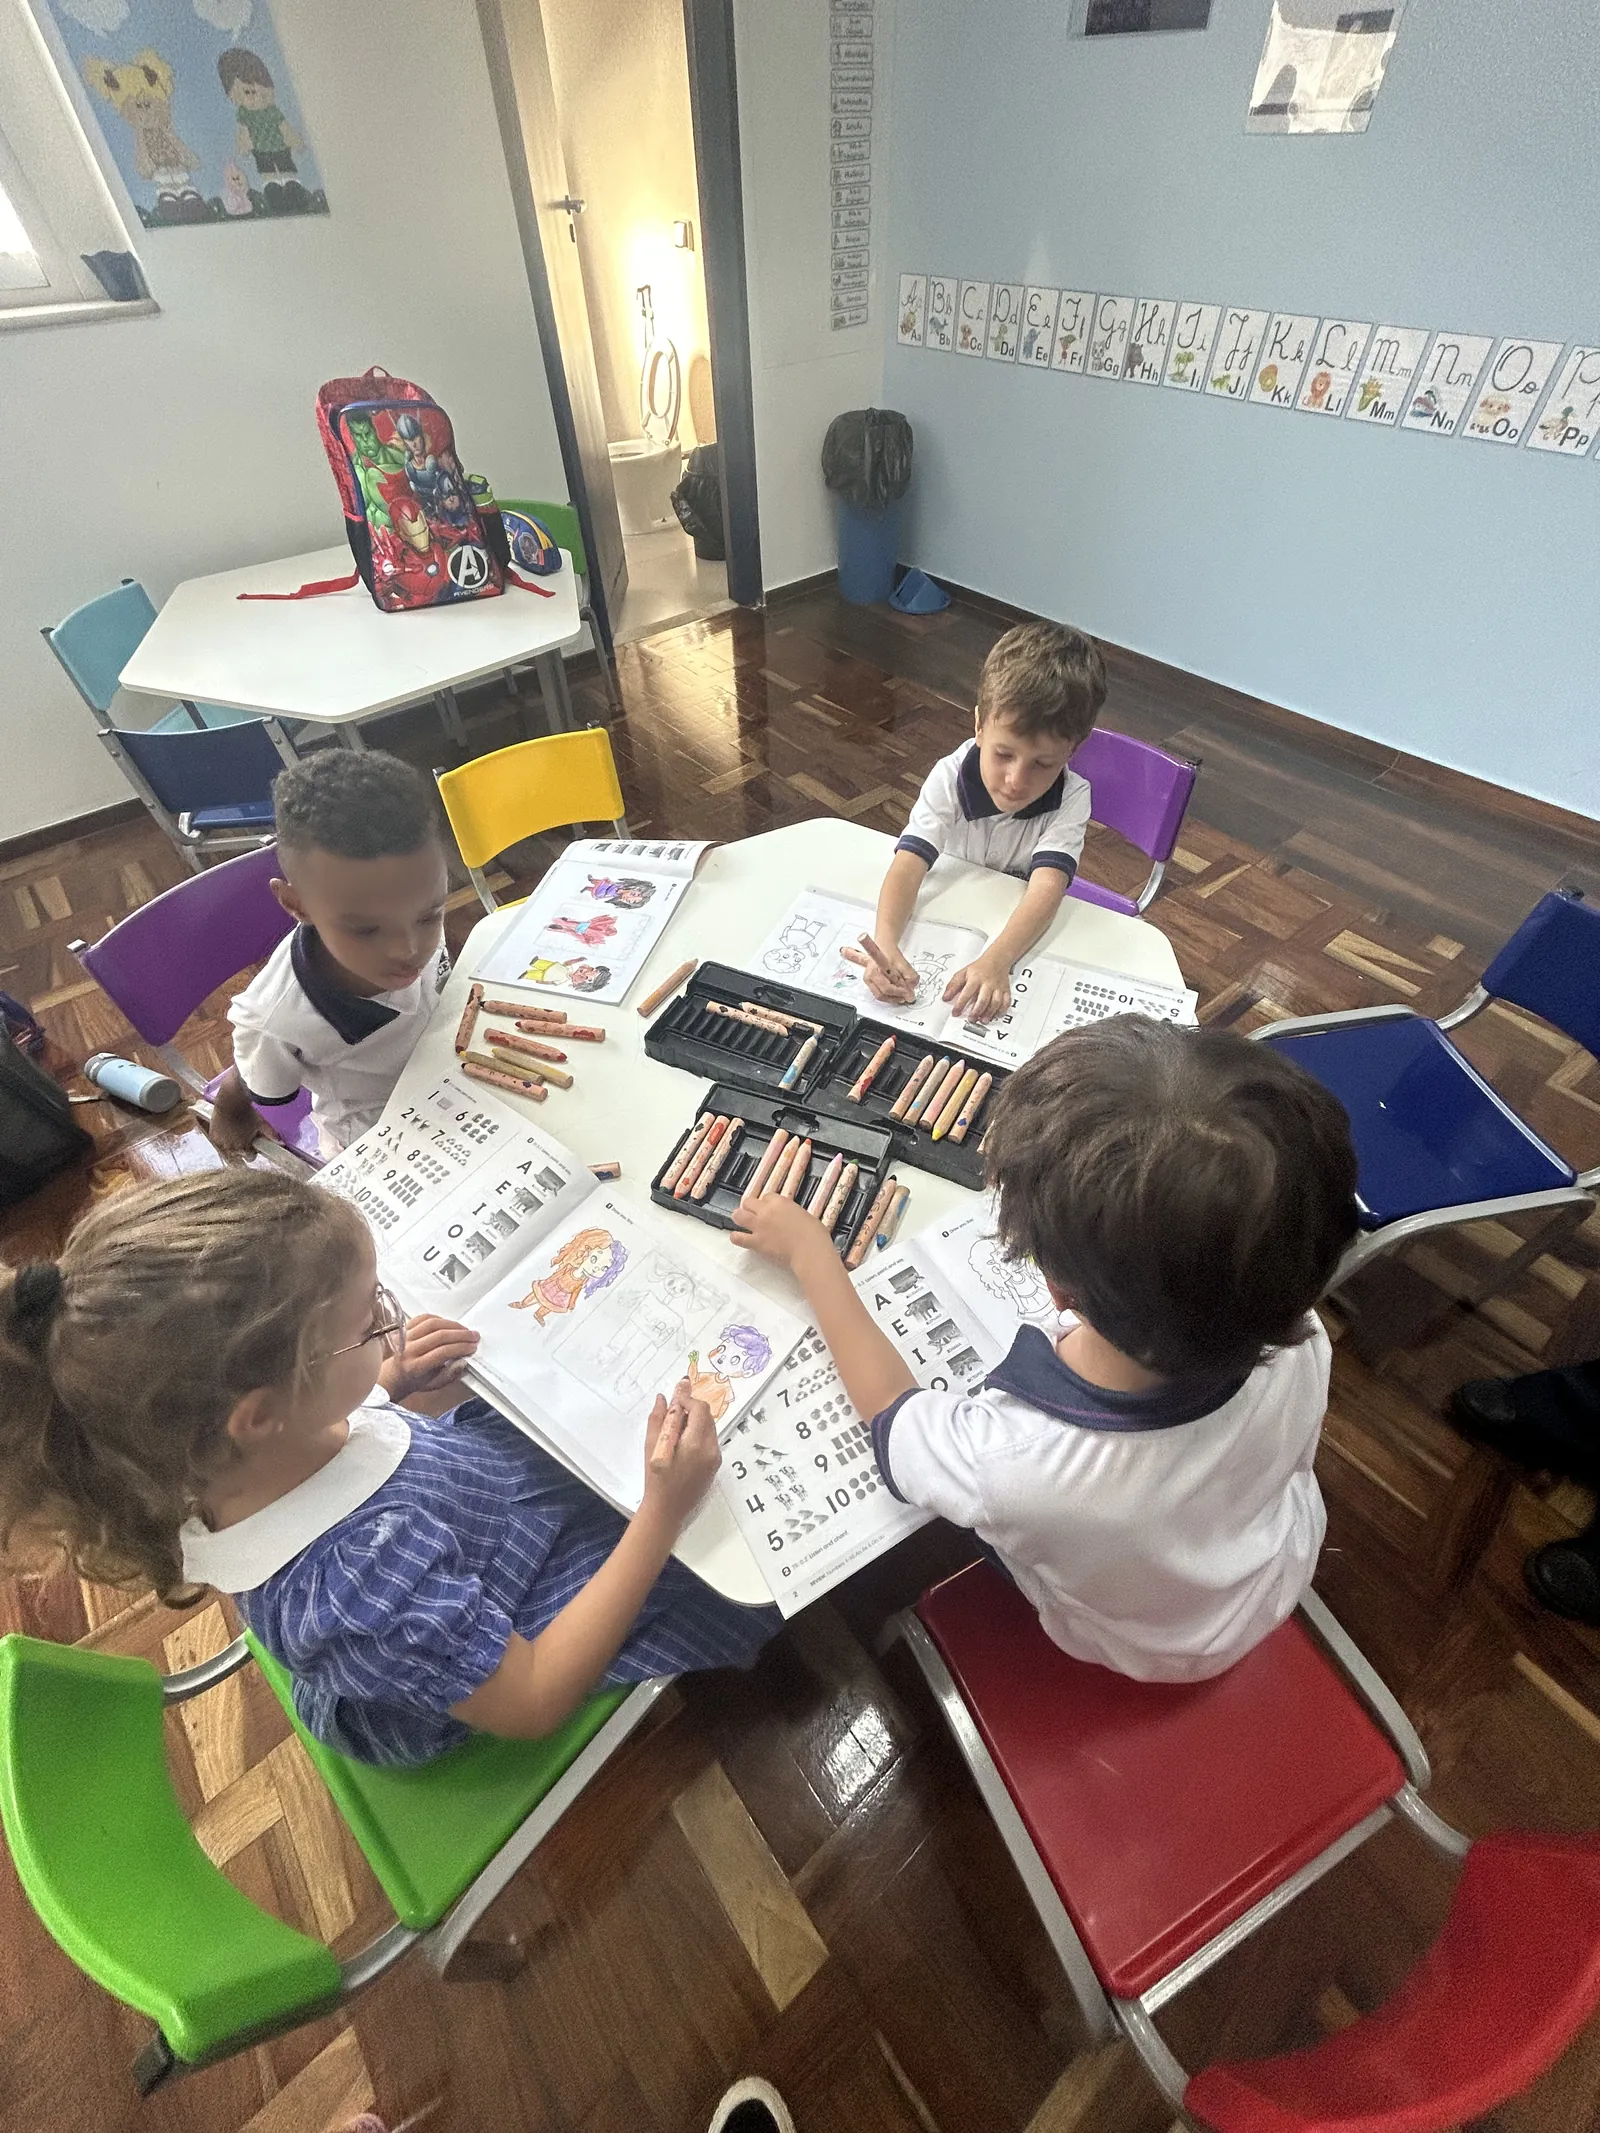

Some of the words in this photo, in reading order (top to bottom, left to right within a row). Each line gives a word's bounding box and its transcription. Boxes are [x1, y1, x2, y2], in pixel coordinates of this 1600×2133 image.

[993, 288, 1019, 325] Dd
[1027, 293, 1051, 328] Ee
[1100, 299, 1127, 350] Gg
[1135, 302, 1166, 346] Hh
[940, 333, 951, 346] Bb
[970, 337, 982, 351] Cc
[1225, 313, 1253, 371] Jj
[1269, 321, 1304, 363] Kk
[1315, 324, 1358, 371] Ll
[1001, 341, 1014, 357] Dd
[1036, 346, 1048, 361] Ee
[1371, 338, 1412, 377] Mm
[1070, 352, 1083, 366] Ff
[1104, 357, 1120, 376] Gg
[1430, 343, 1472, 387] Nn
[1141, 362, 1159, 381] Hh
[1492, 345, 1539, 394] Oo
[1228, 376, 1246, 396] Jj
[1271, 384, 1291, 404] Kk
[1324, 393, 1342, 412] Ll
[1369, 401, 1395, 420] Mm
[1430, 411, 1454, 430] Nn
[1492, 418, 1518, 439] Oo
[1559, 427, 1589, 449] Pp
[1021, 968, 1033, 978] U
[1015, 983, 1028, 993] O
[1011, 999, 1019, 1008] I
[1118, 994, 1134, 1006] 10
[1002, 1014, 1013, 1024] E
[1170, 1008, 1180, 1018] 5
[996, 1029, 1009, 1041] A
[427, 1090, 440, 1100] 1
[401, 1107, 415, 1119] 2
[455, 1111, 469, 1122] 6
[378, 1126, 391, 1138] 3
[431, 1129, 446, 1141] 7
[355, 1143, 369, 1157] 4
[406, 1149, 421, 1161] 8
[330, 1164, 345, 1177] 5
[383, 1169, 397, 1181] 9
[516, 1160, 533, 1175] A
[353, 1186, 372, 1203] 10
[495, 1180, 512, 1195] E
[472, 1202, 487, 1216] I
[447, 1224, 464, 1239] O
[423, 1245, 440, 1262] U
[874, 1293, 892, 1311] A
[891, 1319, 909, 1337] E
[912, 1347, 927, 1365] I
[776, 1388, 790, 1408] 7
[795, 1421, 812, 1440] 8
[731, 1460, 748, 1480] 3
[814, 1453, 828, 1473] 9
[745, 1494, 765, 1514] 4
[825, 1488, 851, 1514] 10
[766, 1529, 784, 1552] 5
[808, 1547, 824, 1559] Listen
[823, 1539, 834, 1550] and
